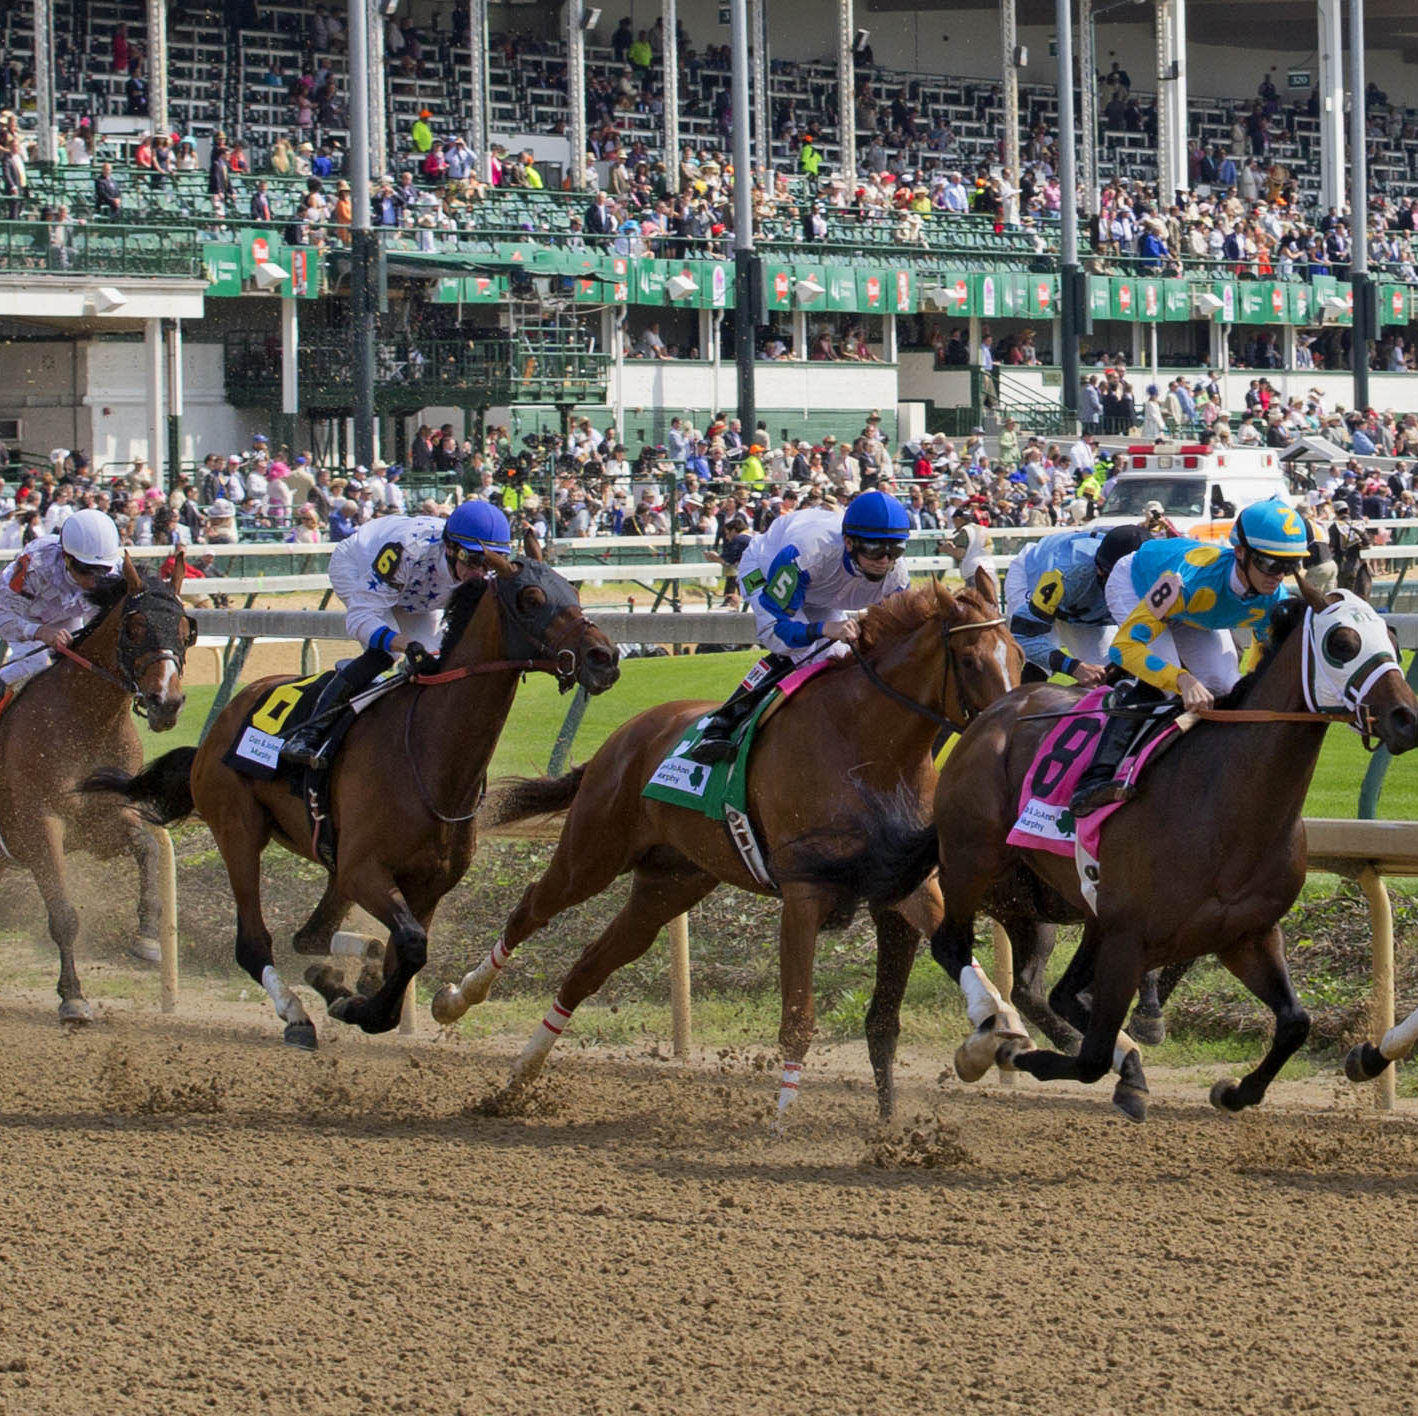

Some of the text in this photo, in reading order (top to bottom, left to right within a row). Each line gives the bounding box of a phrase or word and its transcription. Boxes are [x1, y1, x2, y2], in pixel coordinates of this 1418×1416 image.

[377, 548, 398, 575] 6
[772, 571, 793, 600] 5
[1040, 581, 1057, 605] 4
[1149, 582, 1173, 609] 8
[1031, 716, 1102, 799] 8
